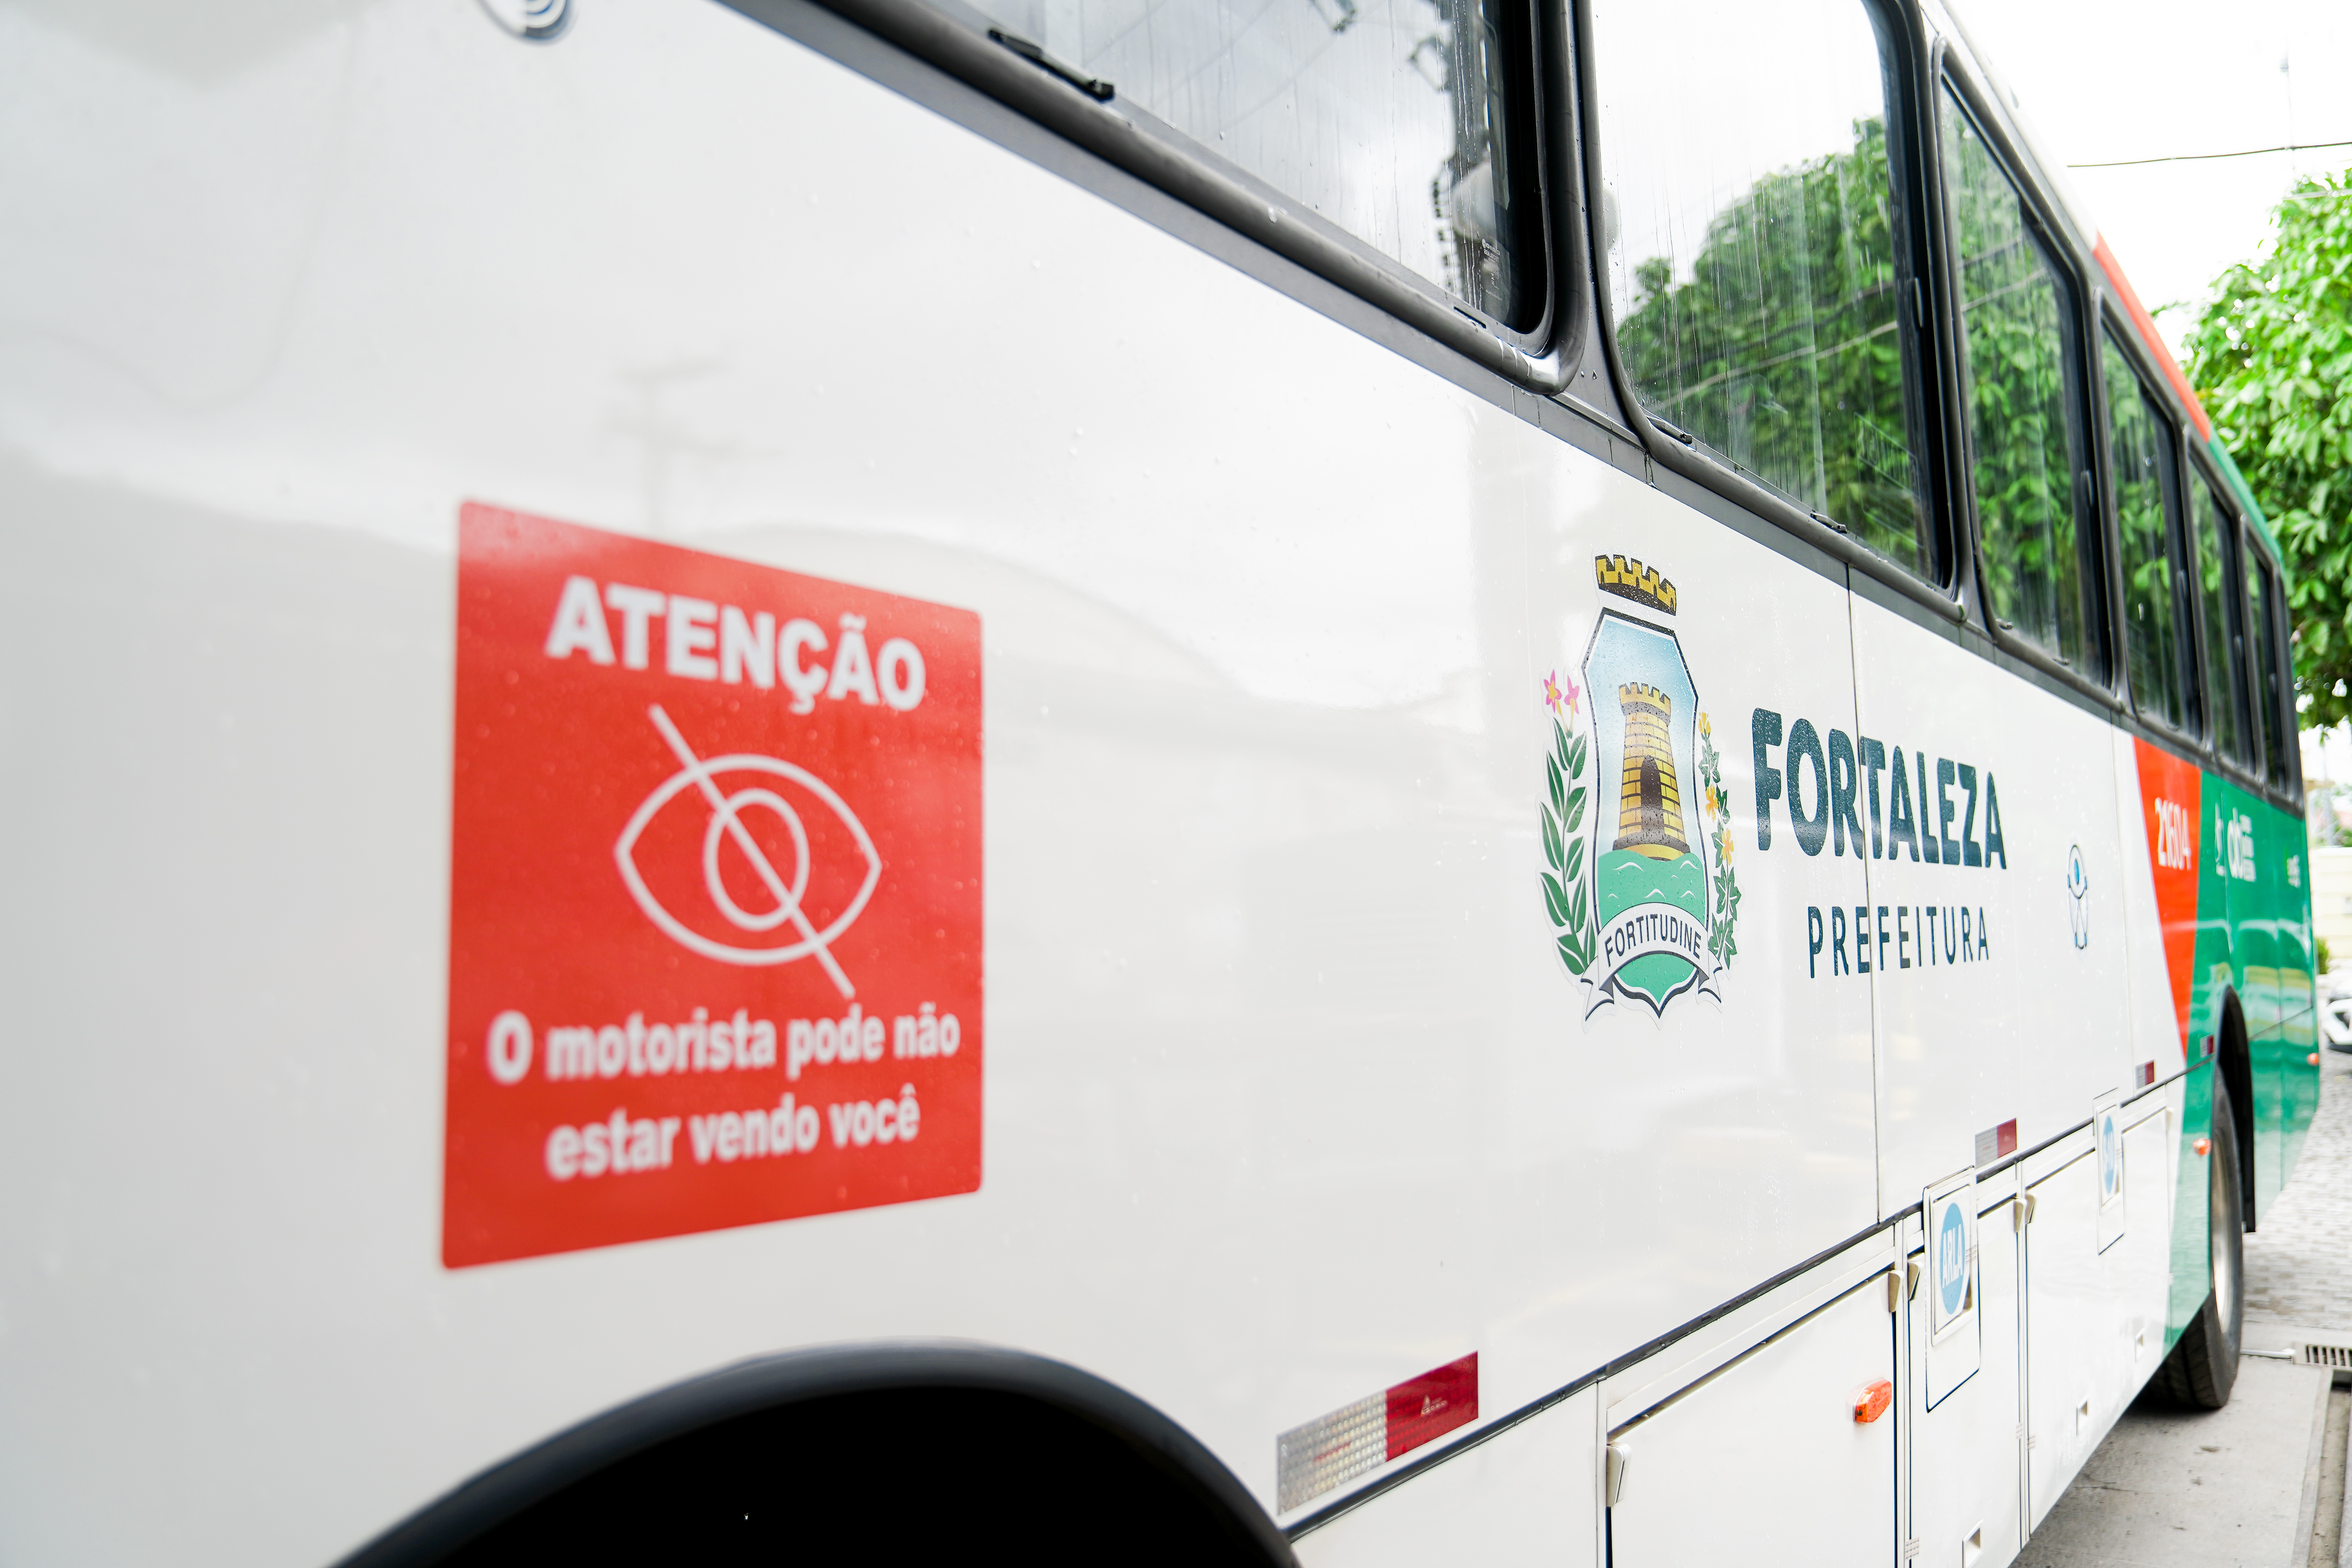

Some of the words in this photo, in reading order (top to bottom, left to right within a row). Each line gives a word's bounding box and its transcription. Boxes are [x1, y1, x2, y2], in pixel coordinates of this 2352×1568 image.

[545, 575, 928, 714] ATENÇÃO
[1751, 708, 2007, 870] FORTALEZA
[2154, 797, 2191, 871] 21604
[1604, 913, 1703, 968] FORTITUDINE
[1808, 906, 1989, 979] PREFEITURA
[486, 1011, 533, 1084] O
[545, 1009, 777, 1082] motorista
[787, 1004, 885, 1080] pode
[894, 1002, 961, 1060] não
[544, 1107, 681, 1181] estar
[689, 1094, 819, 1164] vendo
[828, 1083, 921, 1148] você
[1942, 1223, 1963, 1289] ARLA
